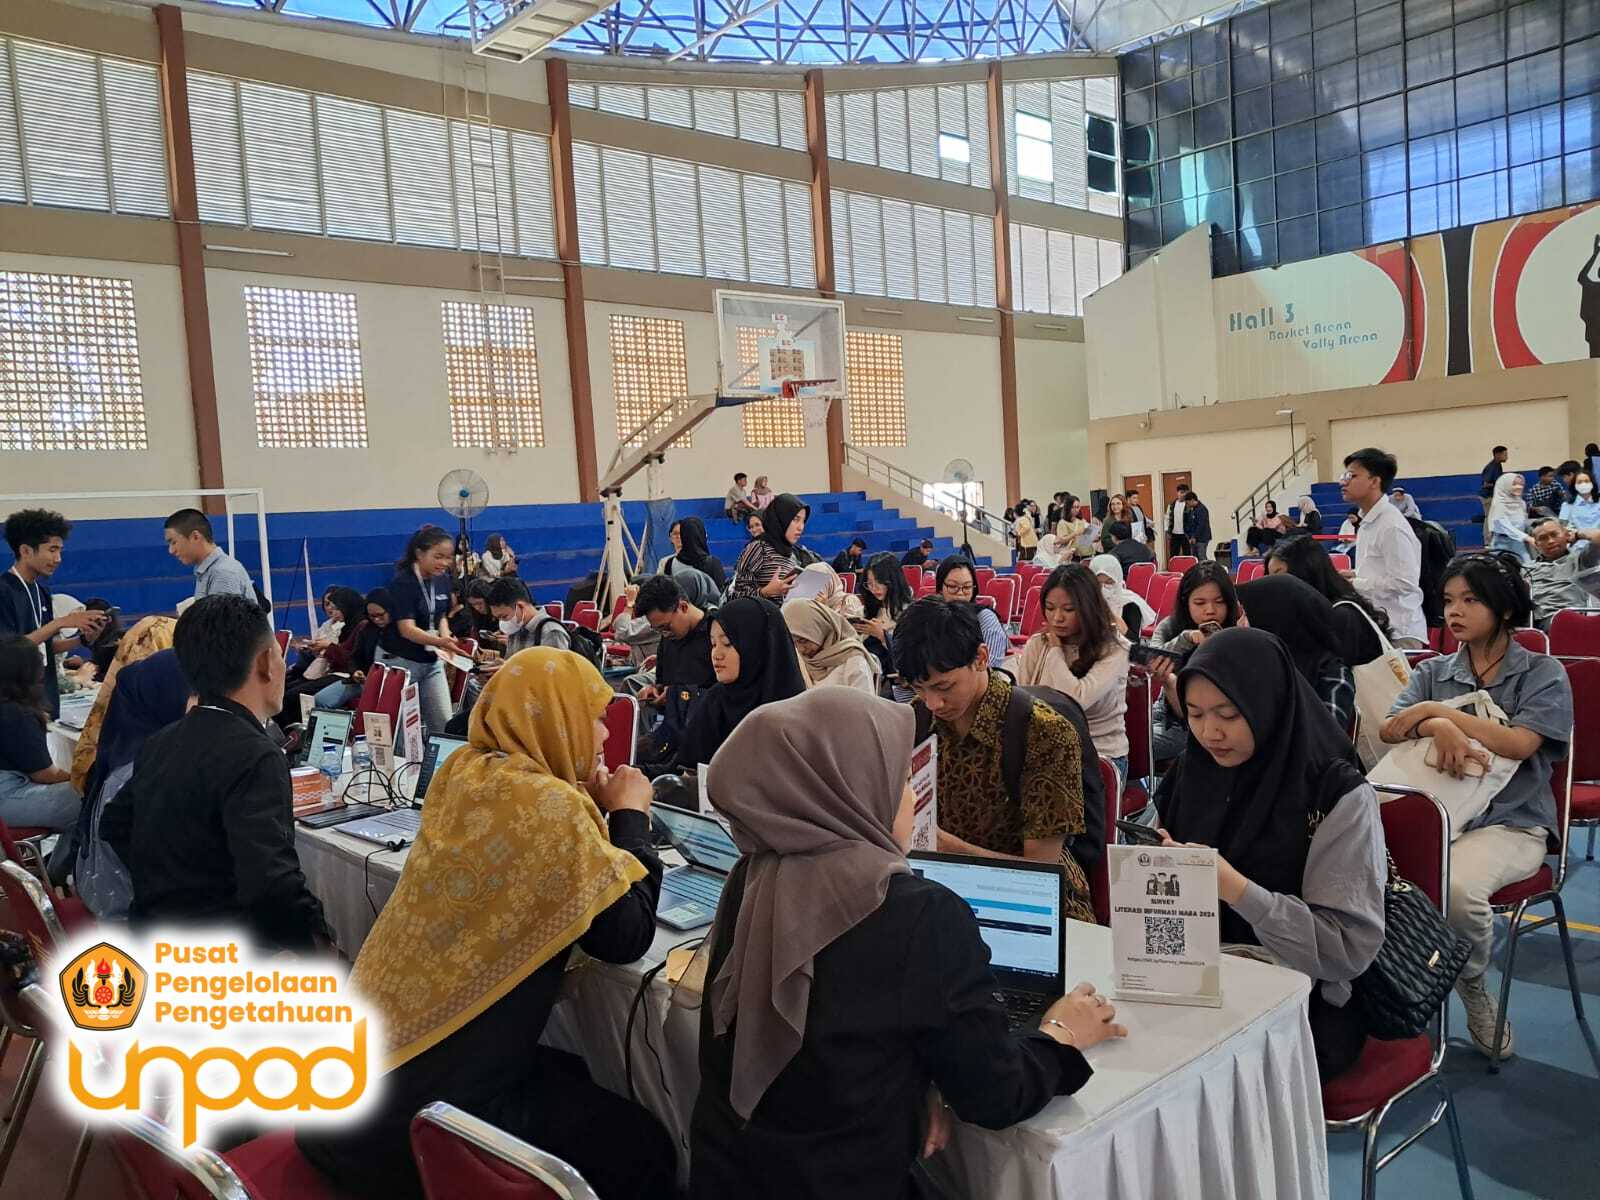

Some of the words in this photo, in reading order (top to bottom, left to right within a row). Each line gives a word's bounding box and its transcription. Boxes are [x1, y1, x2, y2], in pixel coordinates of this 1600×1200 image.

[1229, 306, 1274, 332] Hall
[1284, 303, 1295, 324] 3
[1269, 325, 1310, 341] Basket
[1314, 321, 1352, 335] Arena
[1339, 332, 1378, 346] Arena
[1114, 906, 1143, 914] LITERASI
